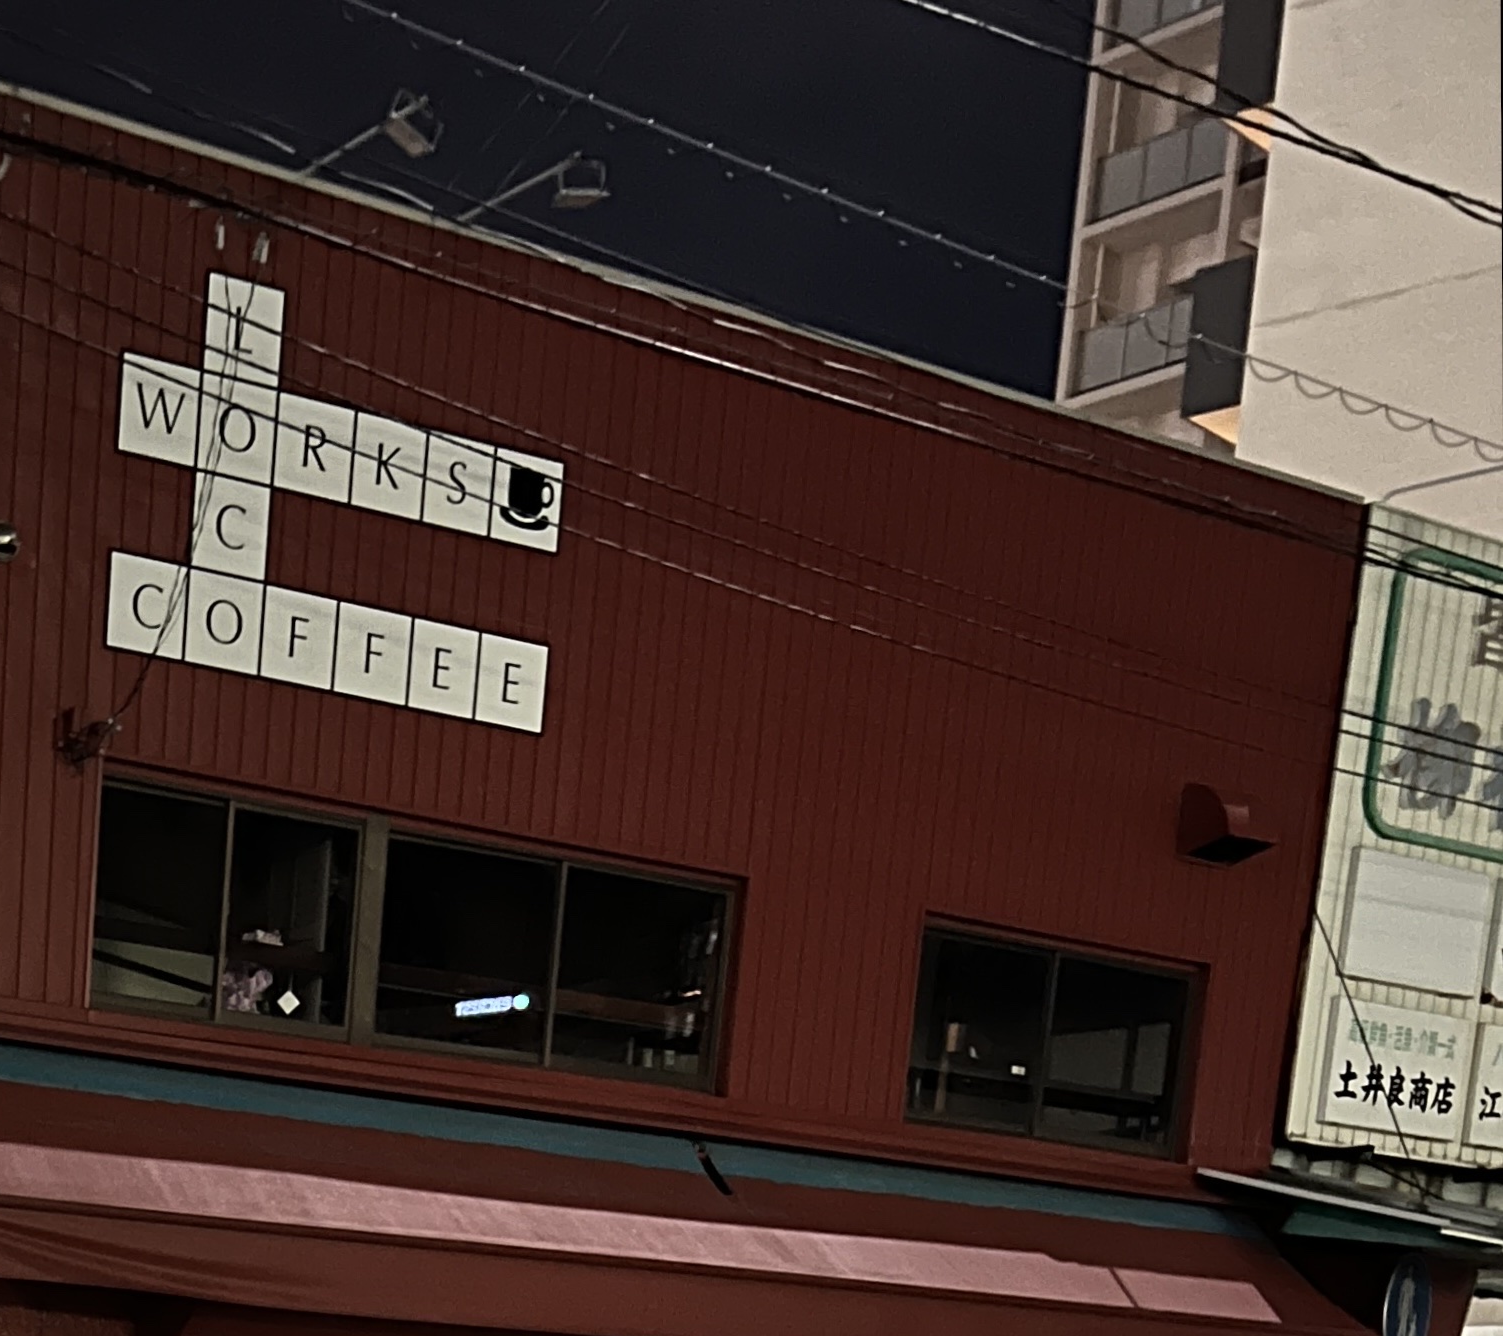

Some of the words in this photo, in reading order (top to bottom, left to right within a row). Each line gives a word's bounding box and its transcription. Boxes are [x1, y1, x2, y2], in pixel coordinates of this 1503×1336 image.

[136, 381, 468, 506] WORKS
[131, 583, 522, 706] COFFEE
[1334, 1059, 1456, 1115] 土井良商店
